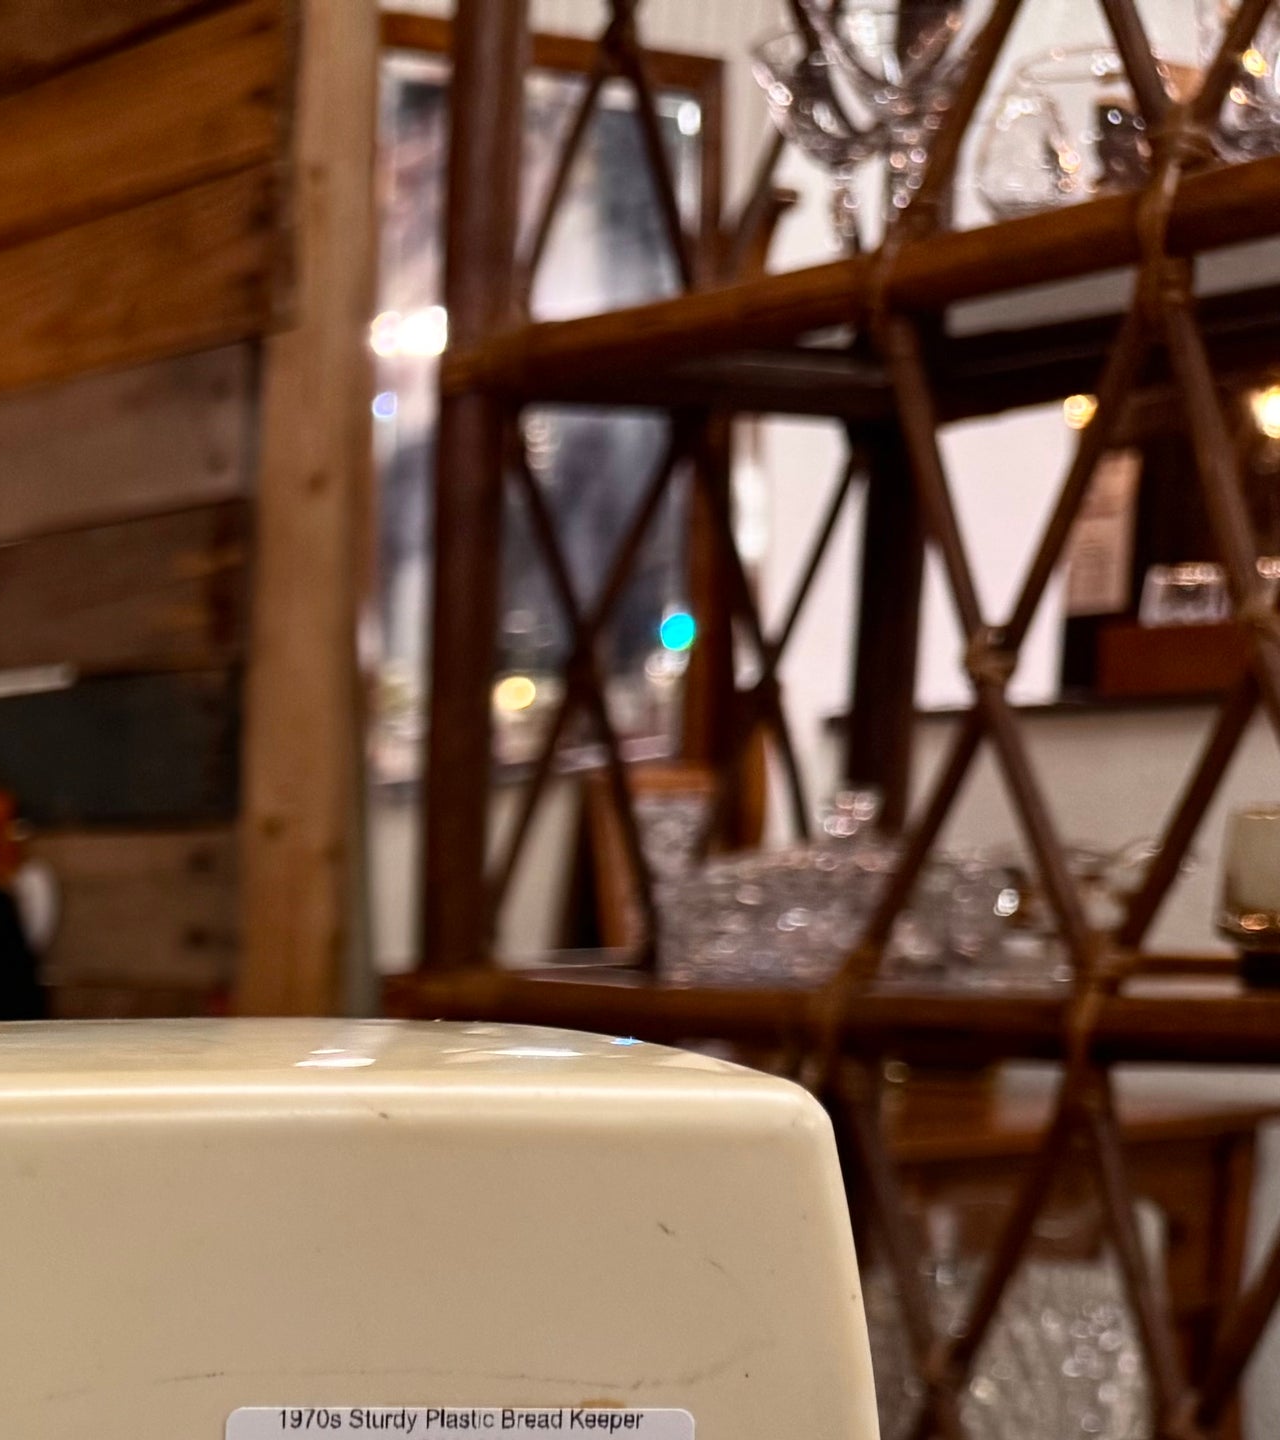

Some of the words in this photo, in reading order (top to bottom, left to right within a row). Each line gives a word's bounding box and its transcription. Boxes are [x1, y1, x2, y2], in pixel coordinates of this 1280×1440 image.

[279, 1408, 342, 1430] 1970s
[348, 1408, 418, 1435] Sturdy
[426, 1408, 495, 1430] Plastic
[501, 1408, 563, 1430] Bread
[570, 1408, 645, 1435] Keeper
